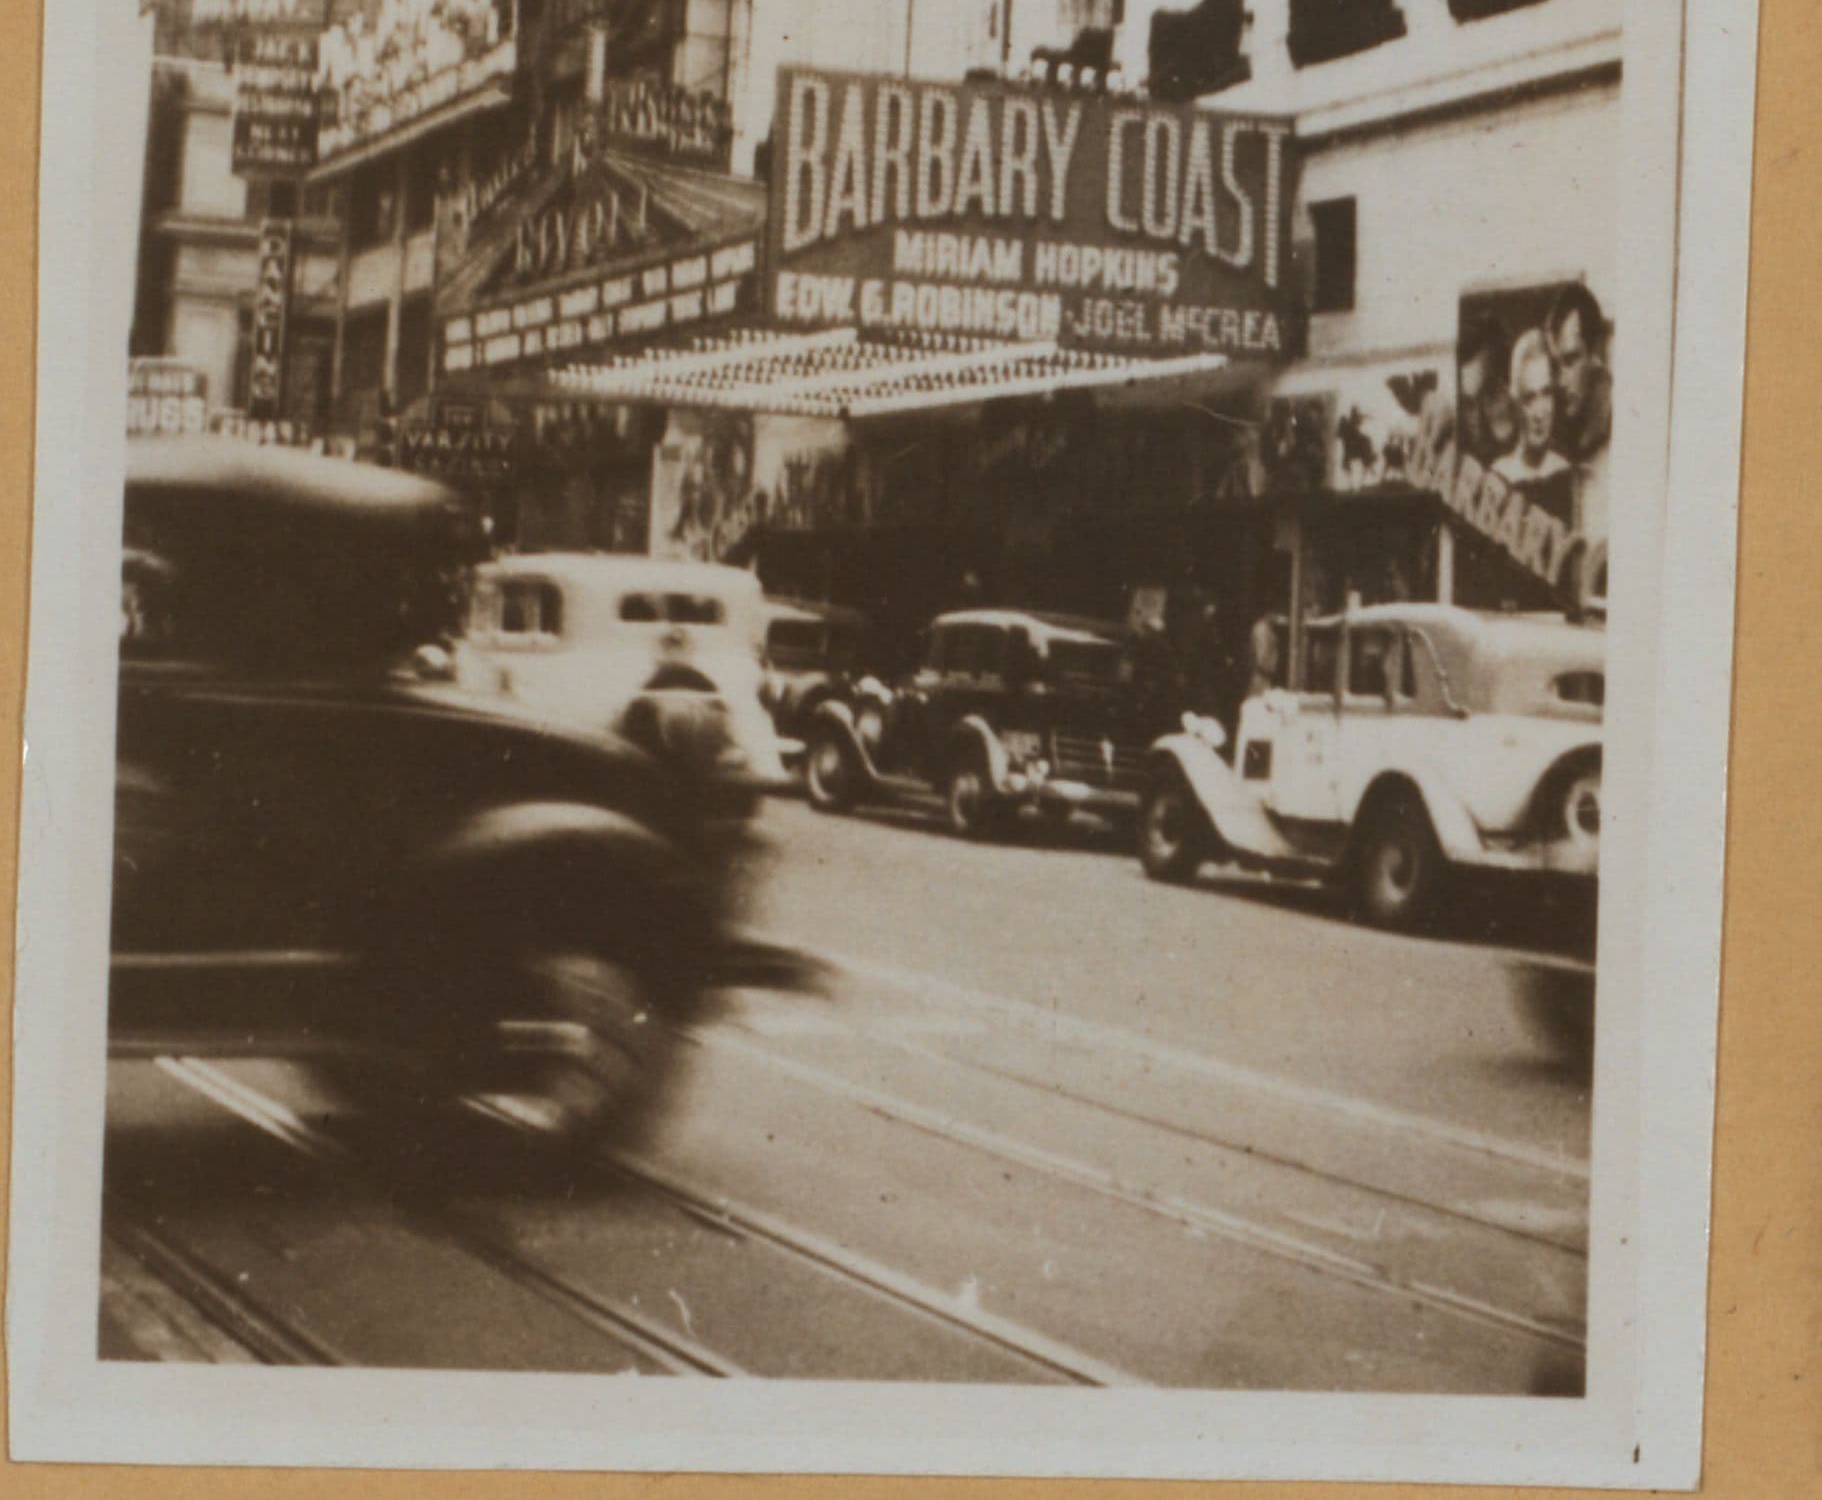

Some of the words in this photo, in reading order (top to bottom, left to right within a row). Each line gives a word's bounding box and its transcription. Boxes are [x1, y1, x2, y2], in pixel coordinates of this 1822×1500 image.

[782, 72, 1083, 255] BARBARY
[1105, 106, 1290, 290] COAST
[893, 229, 1024, 284] MIRIAM
[1034, 242, 1181, 298] HOPKINS
[1072, 298, 1152, 341] JOEL
